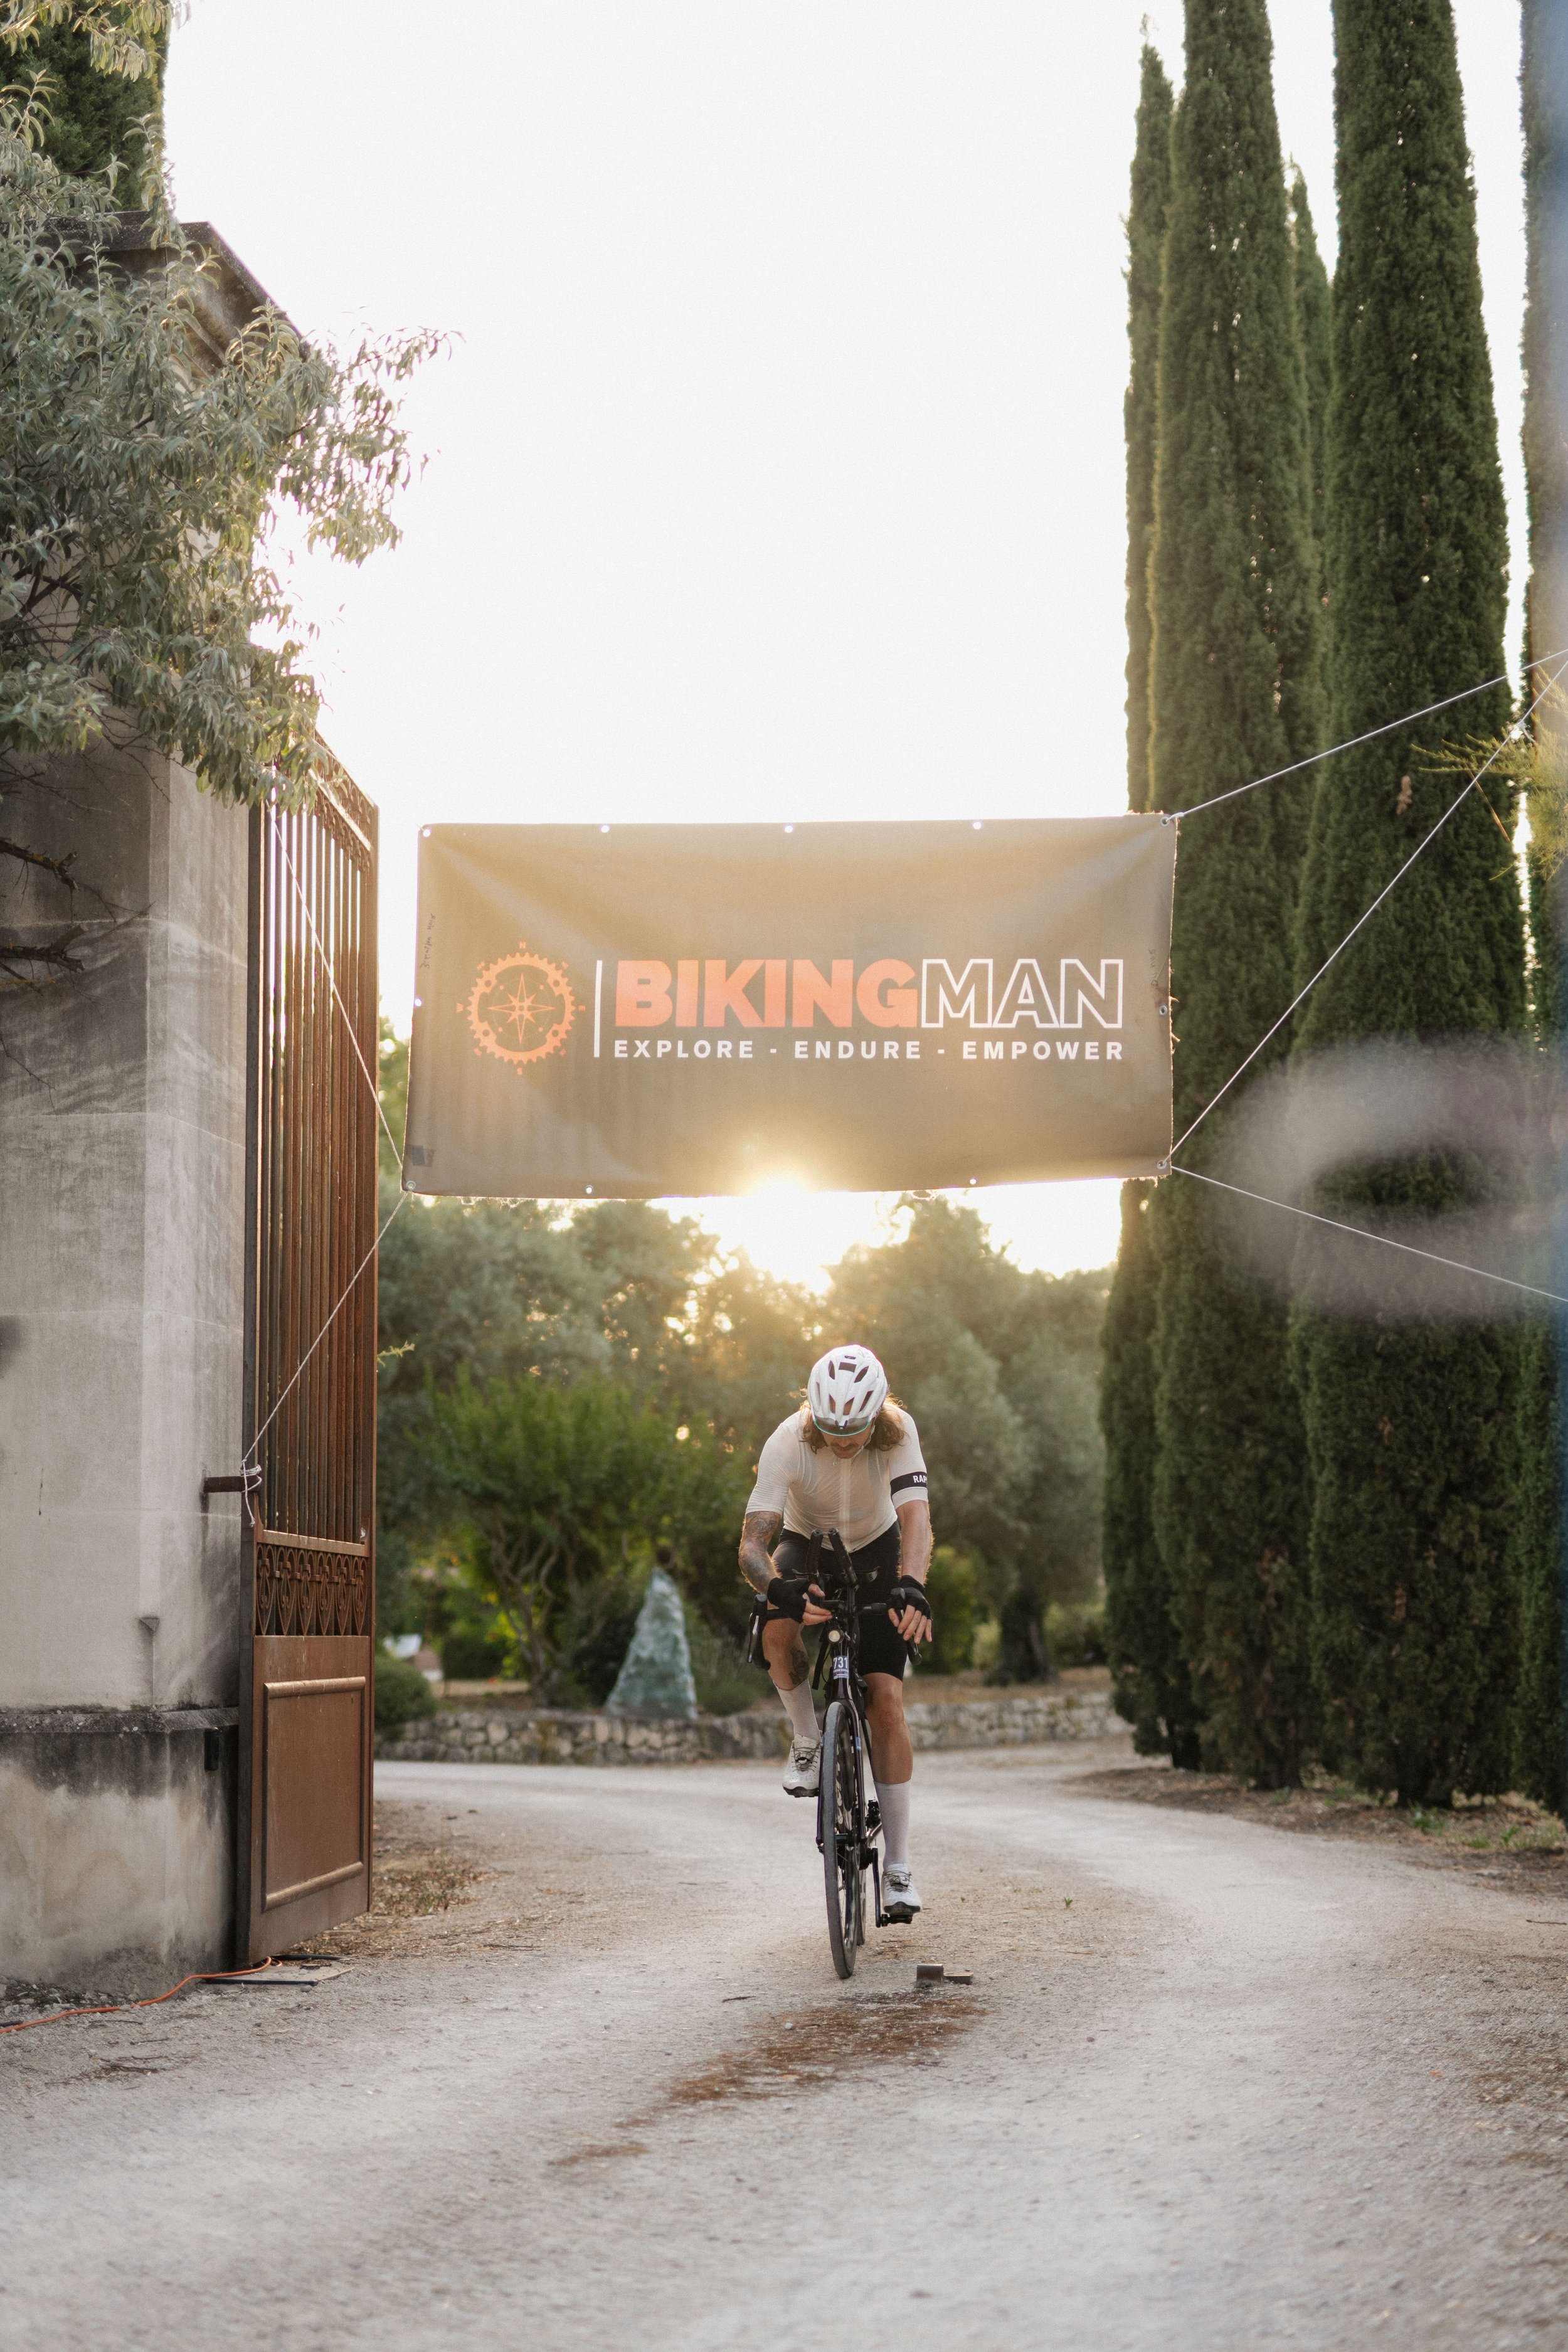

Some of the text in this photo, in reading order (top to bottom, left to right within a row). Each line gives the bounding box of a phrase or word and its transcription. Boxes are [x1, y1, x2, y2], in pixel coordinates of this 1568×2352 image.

[615, 958, 1123, 1029] BIKINGMAN
[614, 1040, 753, 1059] EXPLORE
[794, 1041, 921, 1059] ENDURE
[963, 1041, 1123, 1060] EMPOWER
[833, 1656, 848, 1670] 731
